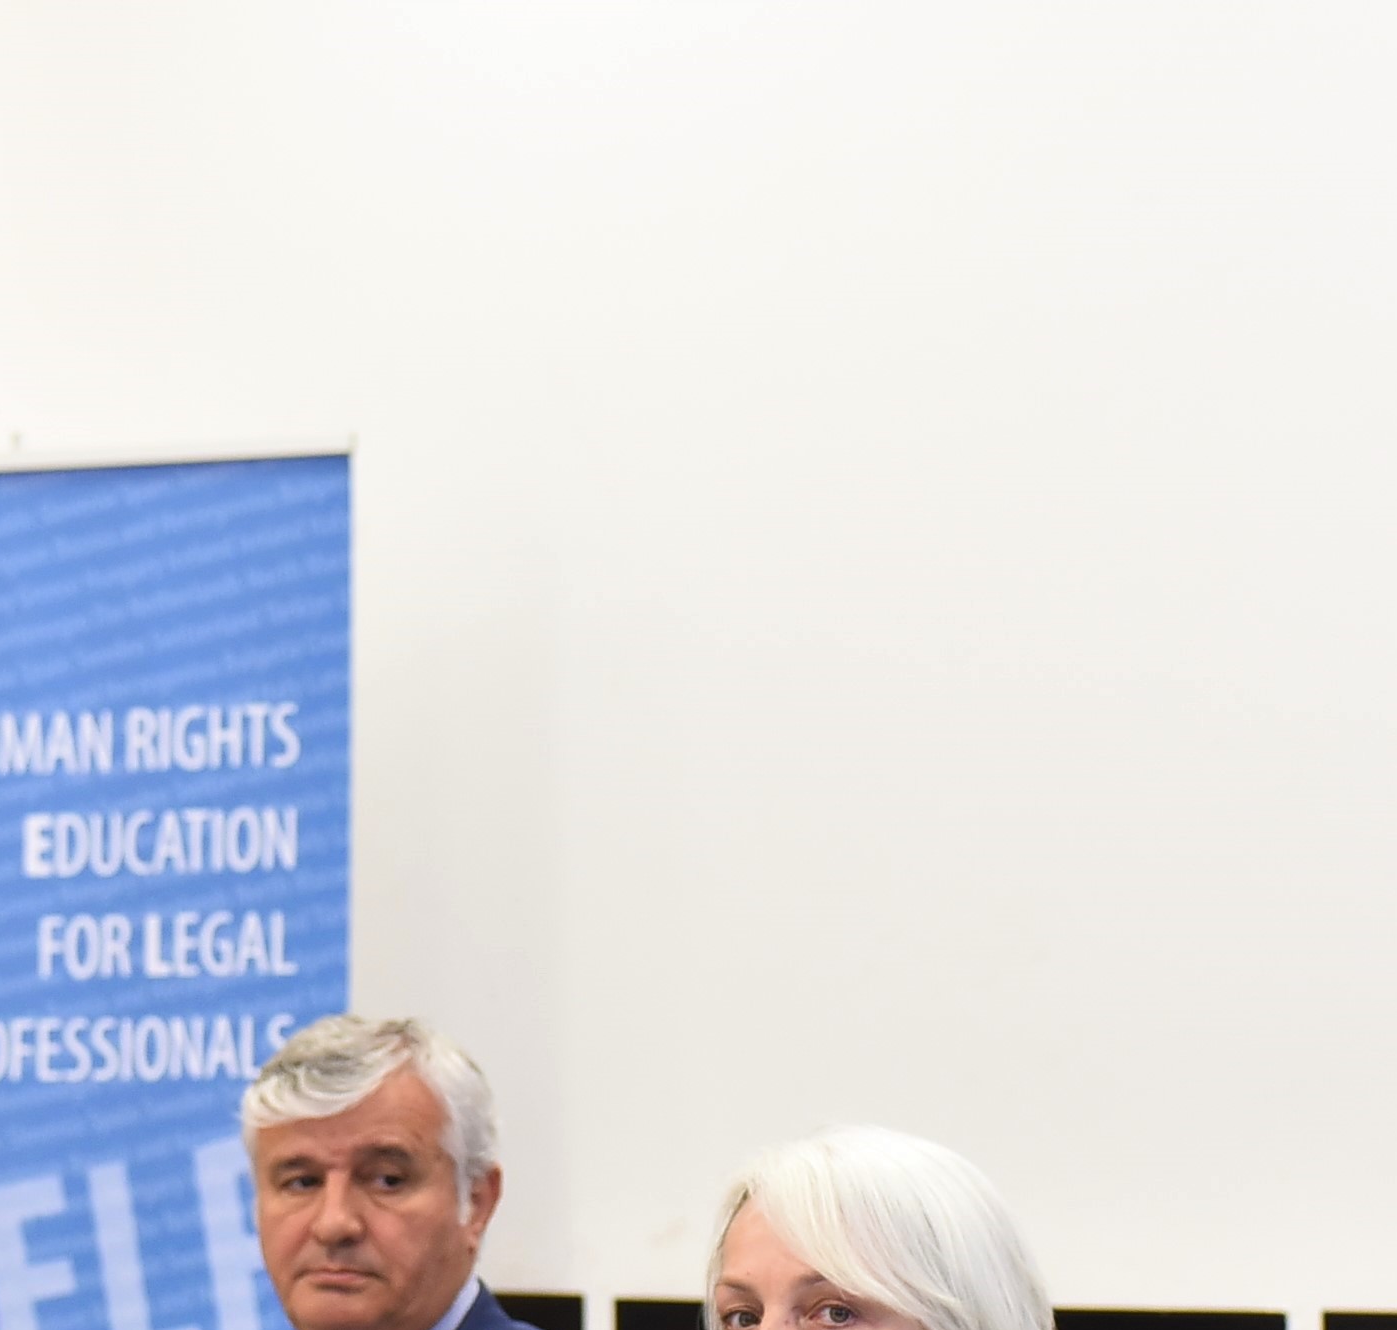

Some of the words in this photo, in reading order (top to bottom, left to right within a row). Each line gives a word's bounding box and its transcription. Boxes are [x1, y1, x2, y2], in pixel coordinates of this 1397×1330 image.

[125, 702, 301, 773] RIGHTS
[22, 806, 300, 878] EDUCATION
[38, 913, 131, 980] FOR
[142, 910, 299, 979] LEGAL
